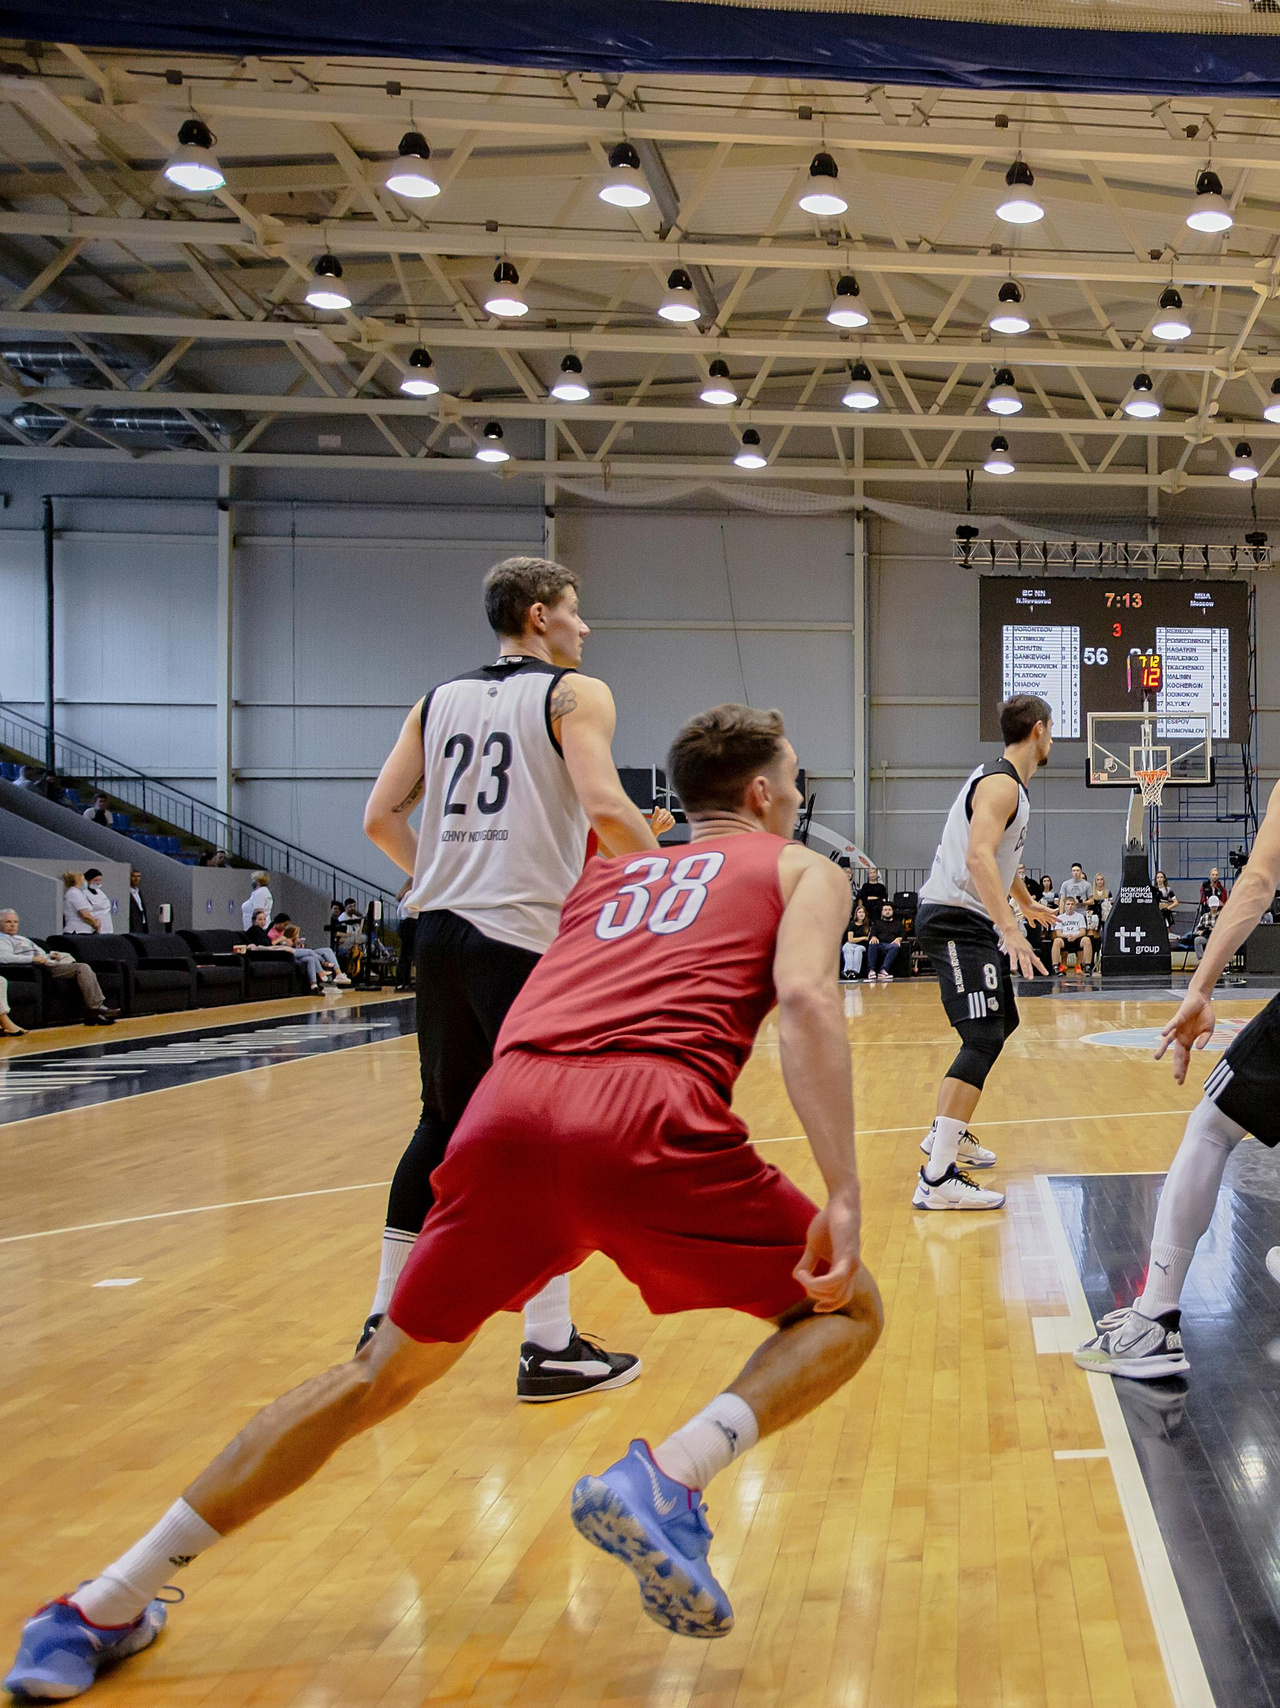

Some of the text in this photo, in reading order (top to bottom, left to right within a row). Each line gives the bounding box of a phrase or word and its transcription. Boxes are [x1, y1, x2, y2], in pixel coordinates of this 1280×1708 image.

[1104, 592, 1143, 608] 7:13
[1112, 622, 1122, 637] 3
[1083, 647, 1109, 665] 56
[1143, 668, 1161, 686] 12
[444, 731, 513, 817] 23
[594, 850, 726, 940] 38
[1135, 945, 1160, 955] group
[983, 963, 998, 990] 8
